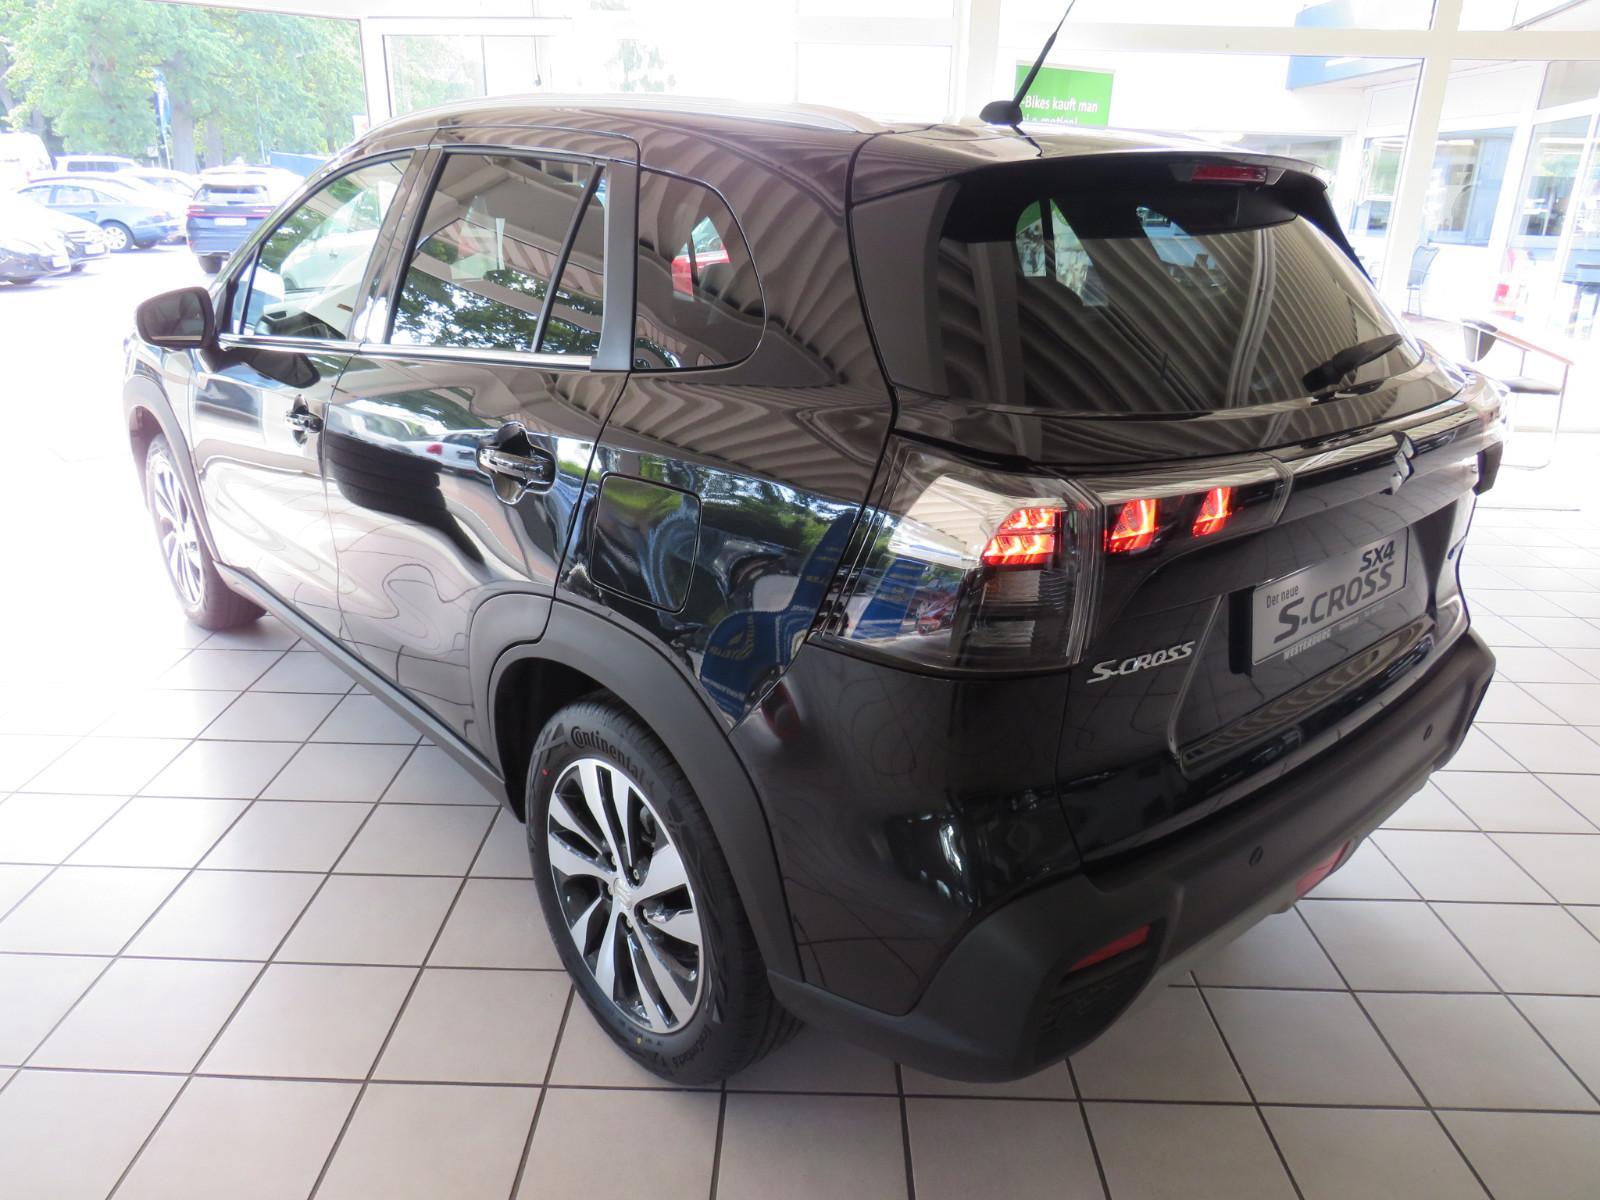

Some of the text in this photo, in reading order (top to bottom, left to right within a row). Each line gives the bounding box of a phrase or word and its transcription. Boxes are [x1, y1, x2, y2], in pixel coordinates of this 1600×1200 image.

[1052, 96, 1077, 112] kauft
[1078, 101, 1098, 112] man
[1359, 540, 1395, 573] SX4
[1266, 584, 1299, 609] Der neue
[571, 726, 646, 786] Continental
